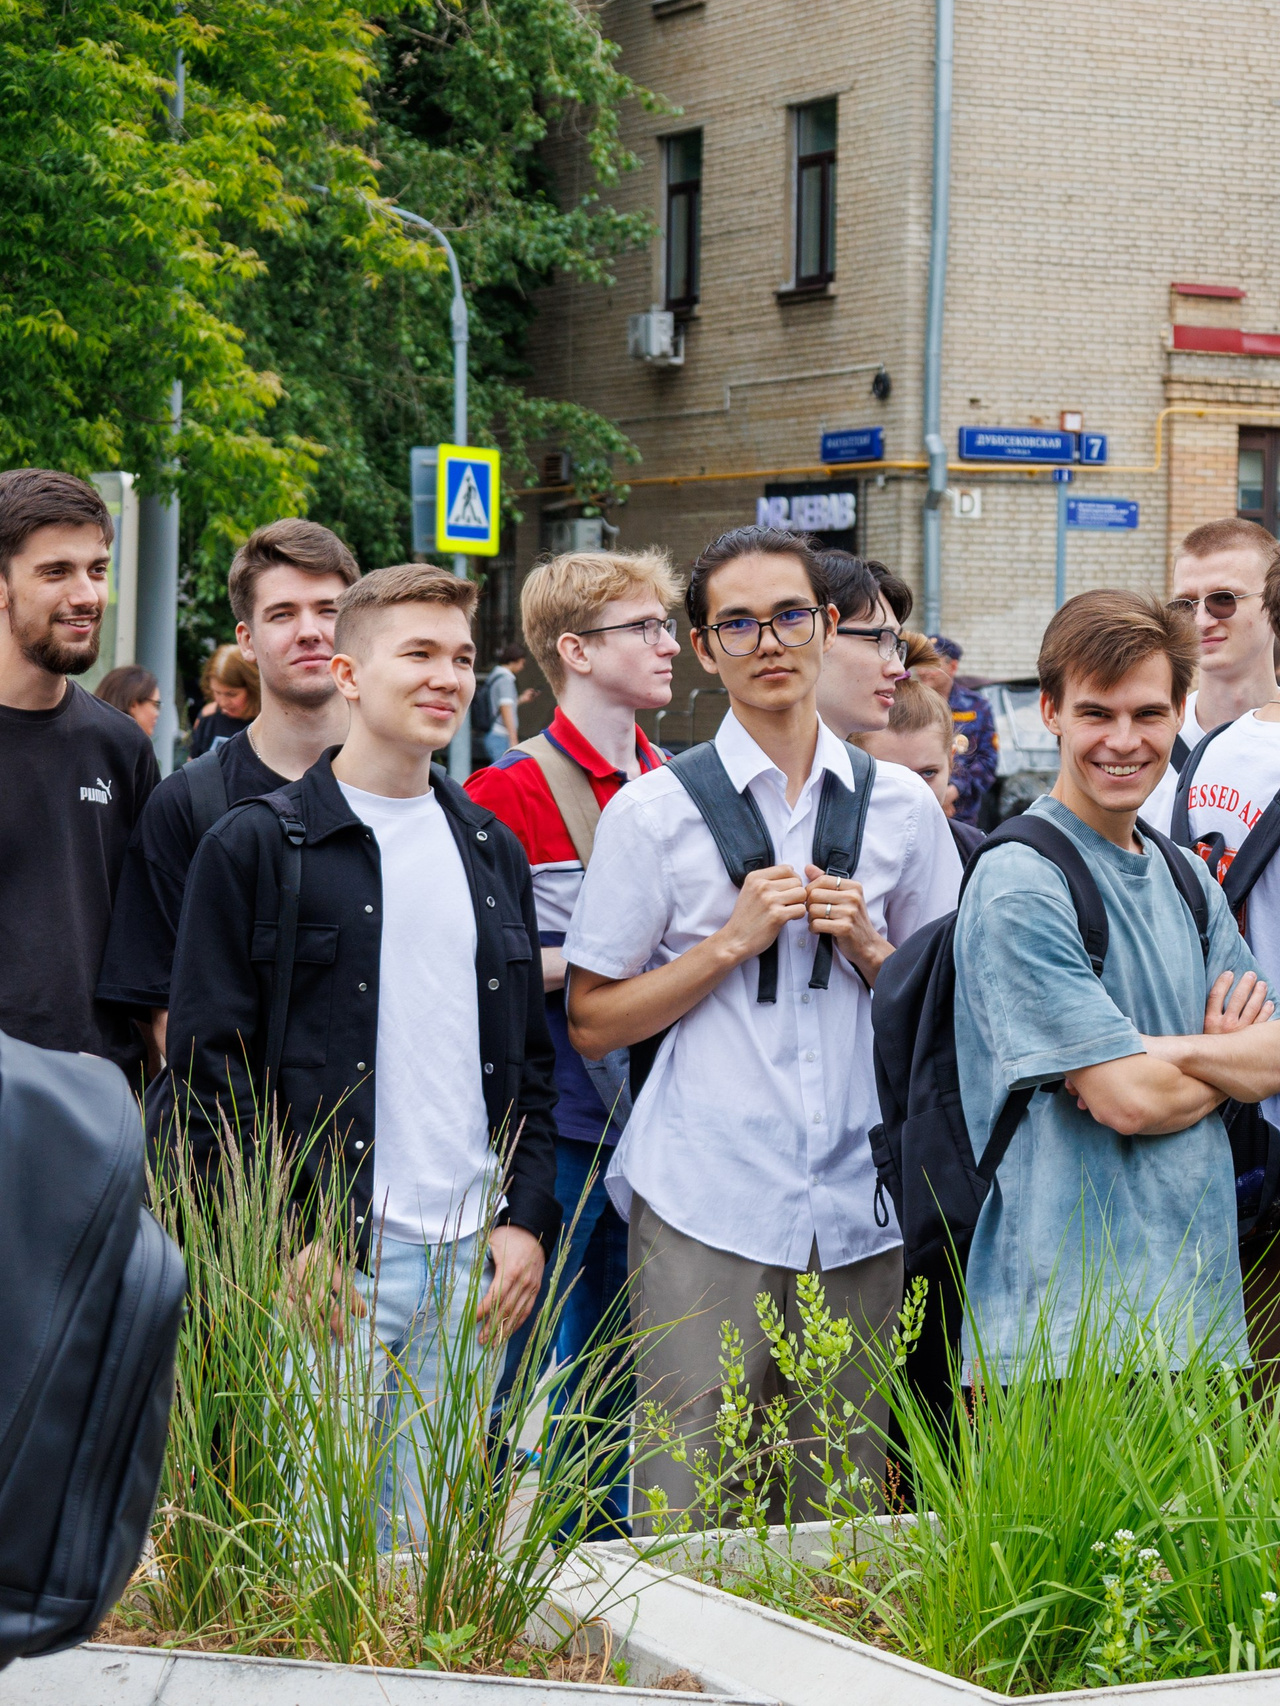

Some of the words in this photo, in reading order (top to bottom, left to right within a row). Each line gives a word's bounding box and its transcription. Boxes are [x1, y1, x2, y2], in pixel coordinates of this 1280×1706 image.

[975, 433, 1062, 449] ДУБОСЕКОВСКАЯ
[1088, 438, 1102, 458] 7
[80, 787, 108, 804] PUMA
